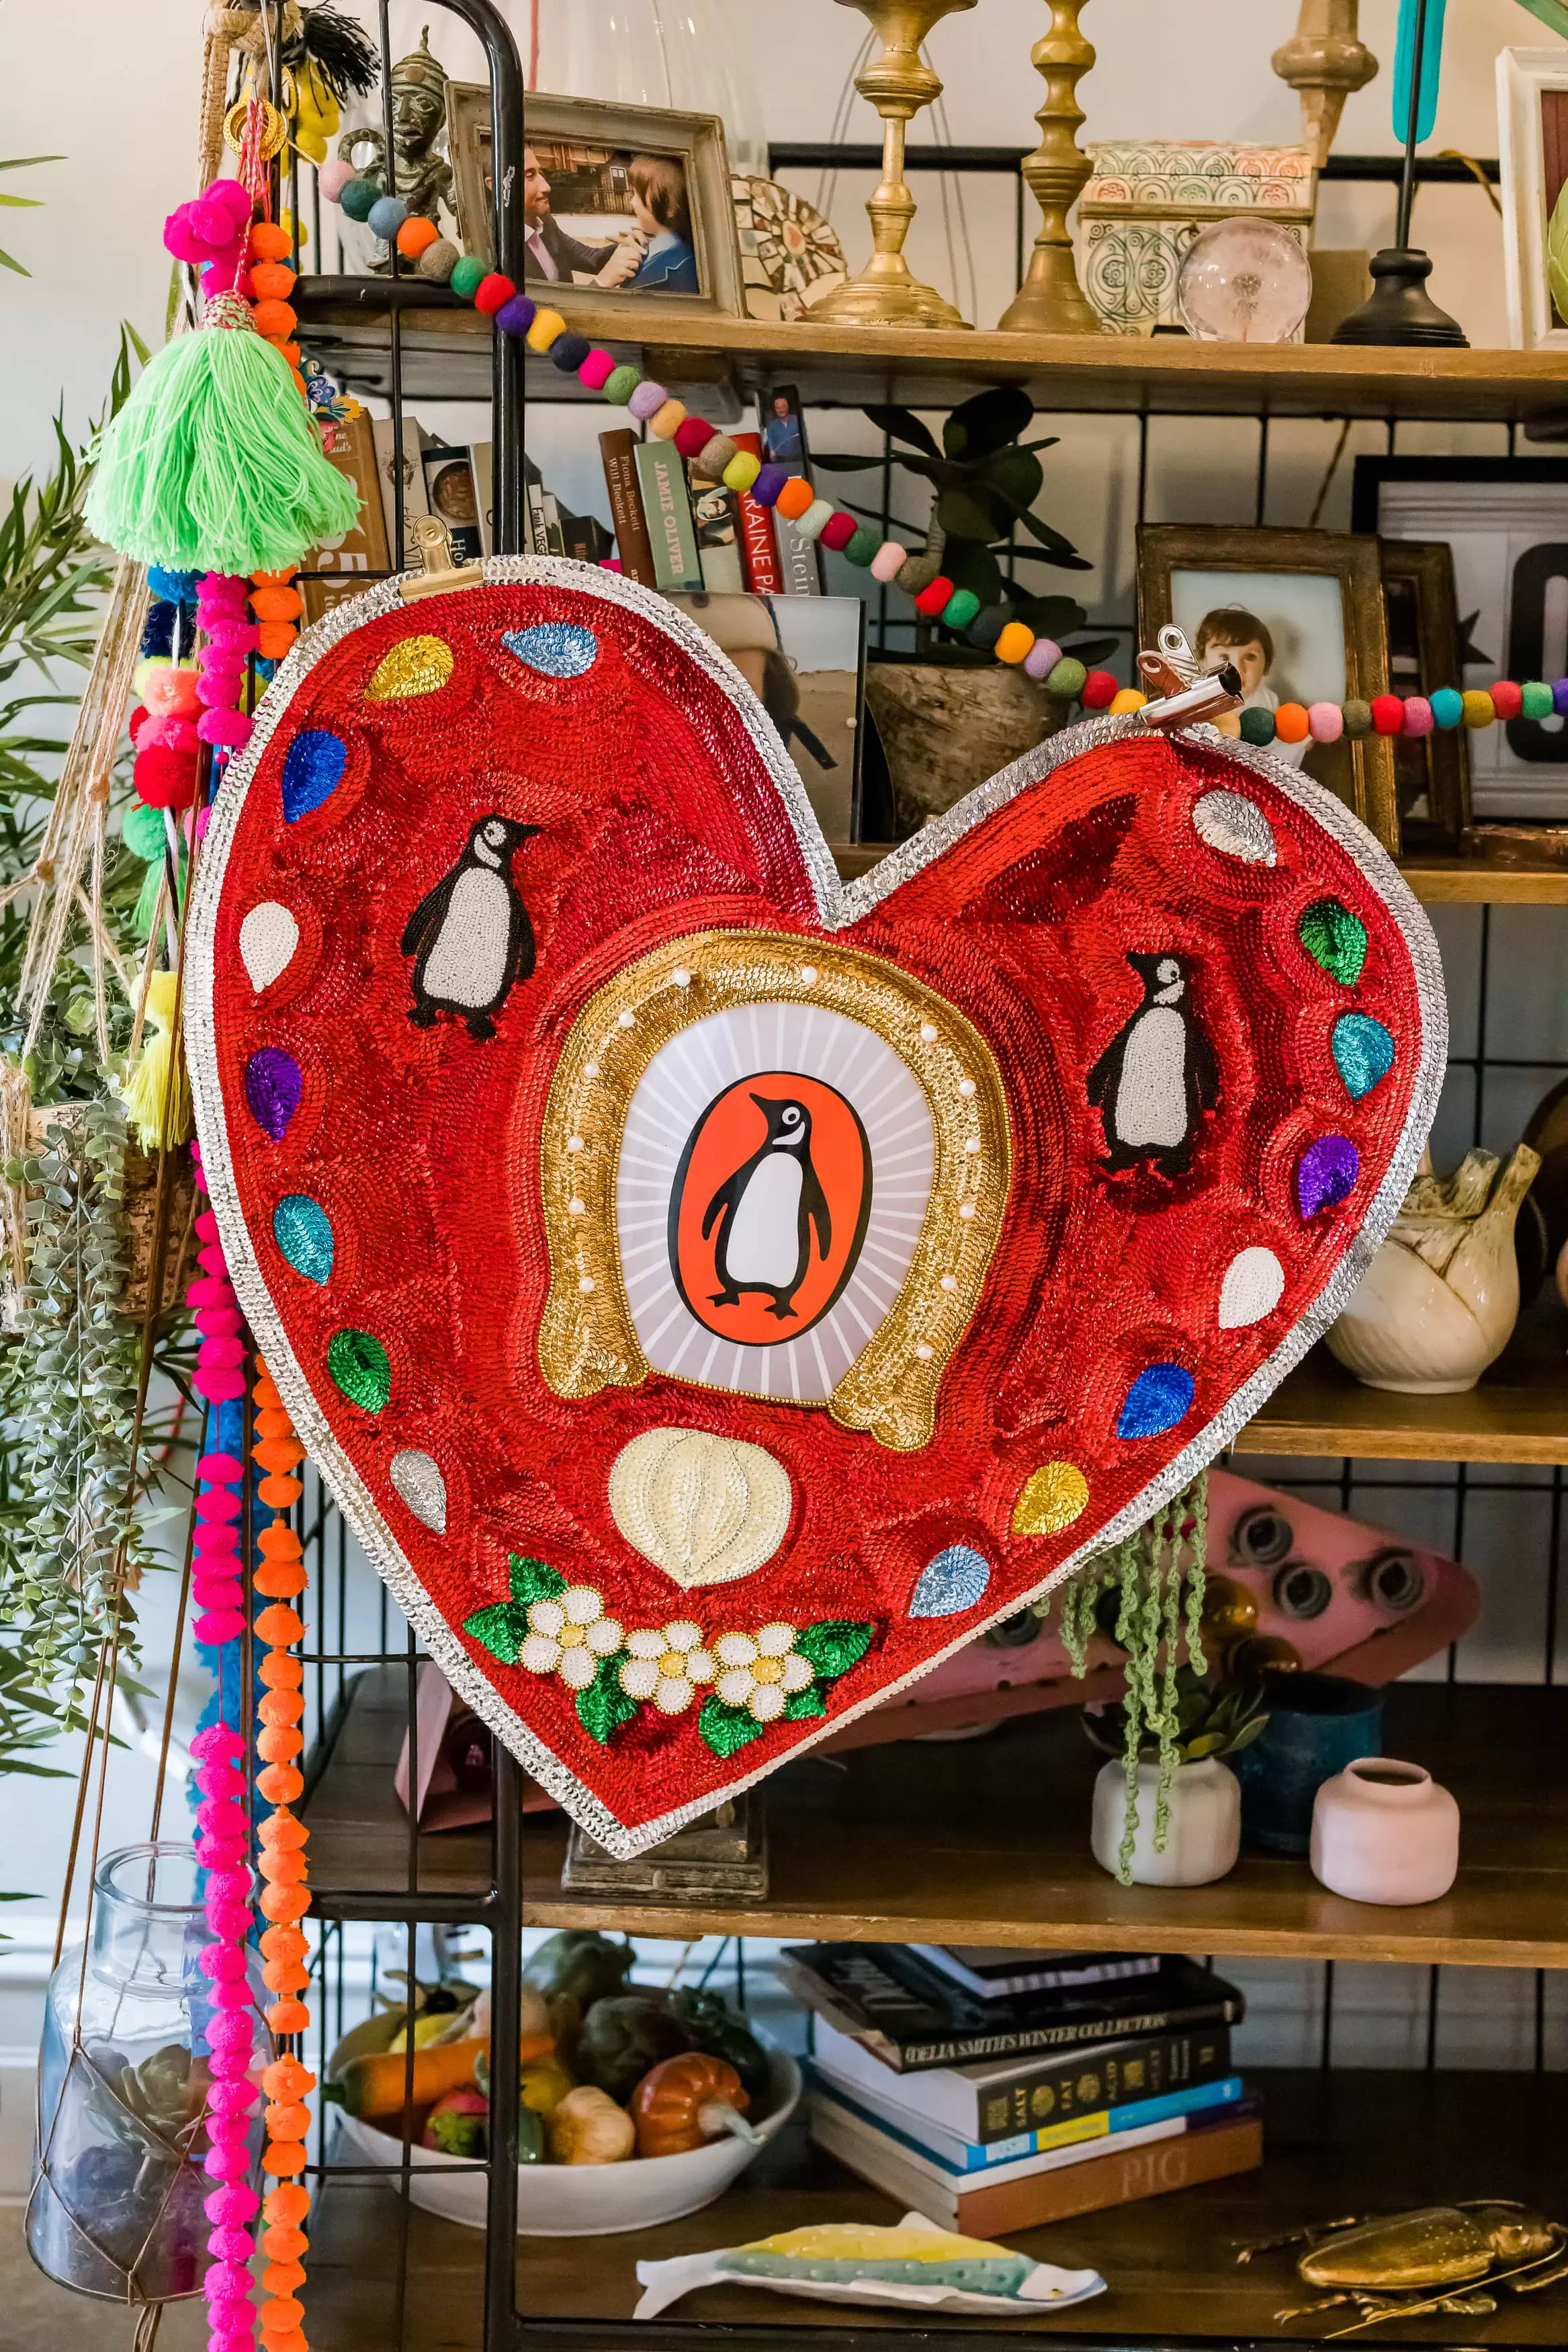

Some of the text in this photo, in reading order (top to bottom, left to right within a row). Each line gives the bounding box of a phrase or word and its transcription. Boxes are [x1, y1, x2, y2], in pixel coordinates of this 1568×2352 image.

[608, 457, 627, 525] Will Beckett
[620, 456, 640, 532] Fiona Beckett
[531, 507, 543, 530] Fresh
[655, 461, 685, 575] JAMIE OLIVER
[743, 491, 772, 568] RAINE
[906, 2044, 955, 2062] DELIA
[1019, 2025, 1076, 2048] WINTER
[1077, 2014, 1167, 2038] COLLECTION
[1061, 2081, 1075, 2110] FAT
[1106, 2060, 1118, 2101] ACID
[1014, 2088, 1028, 2128] SALT
